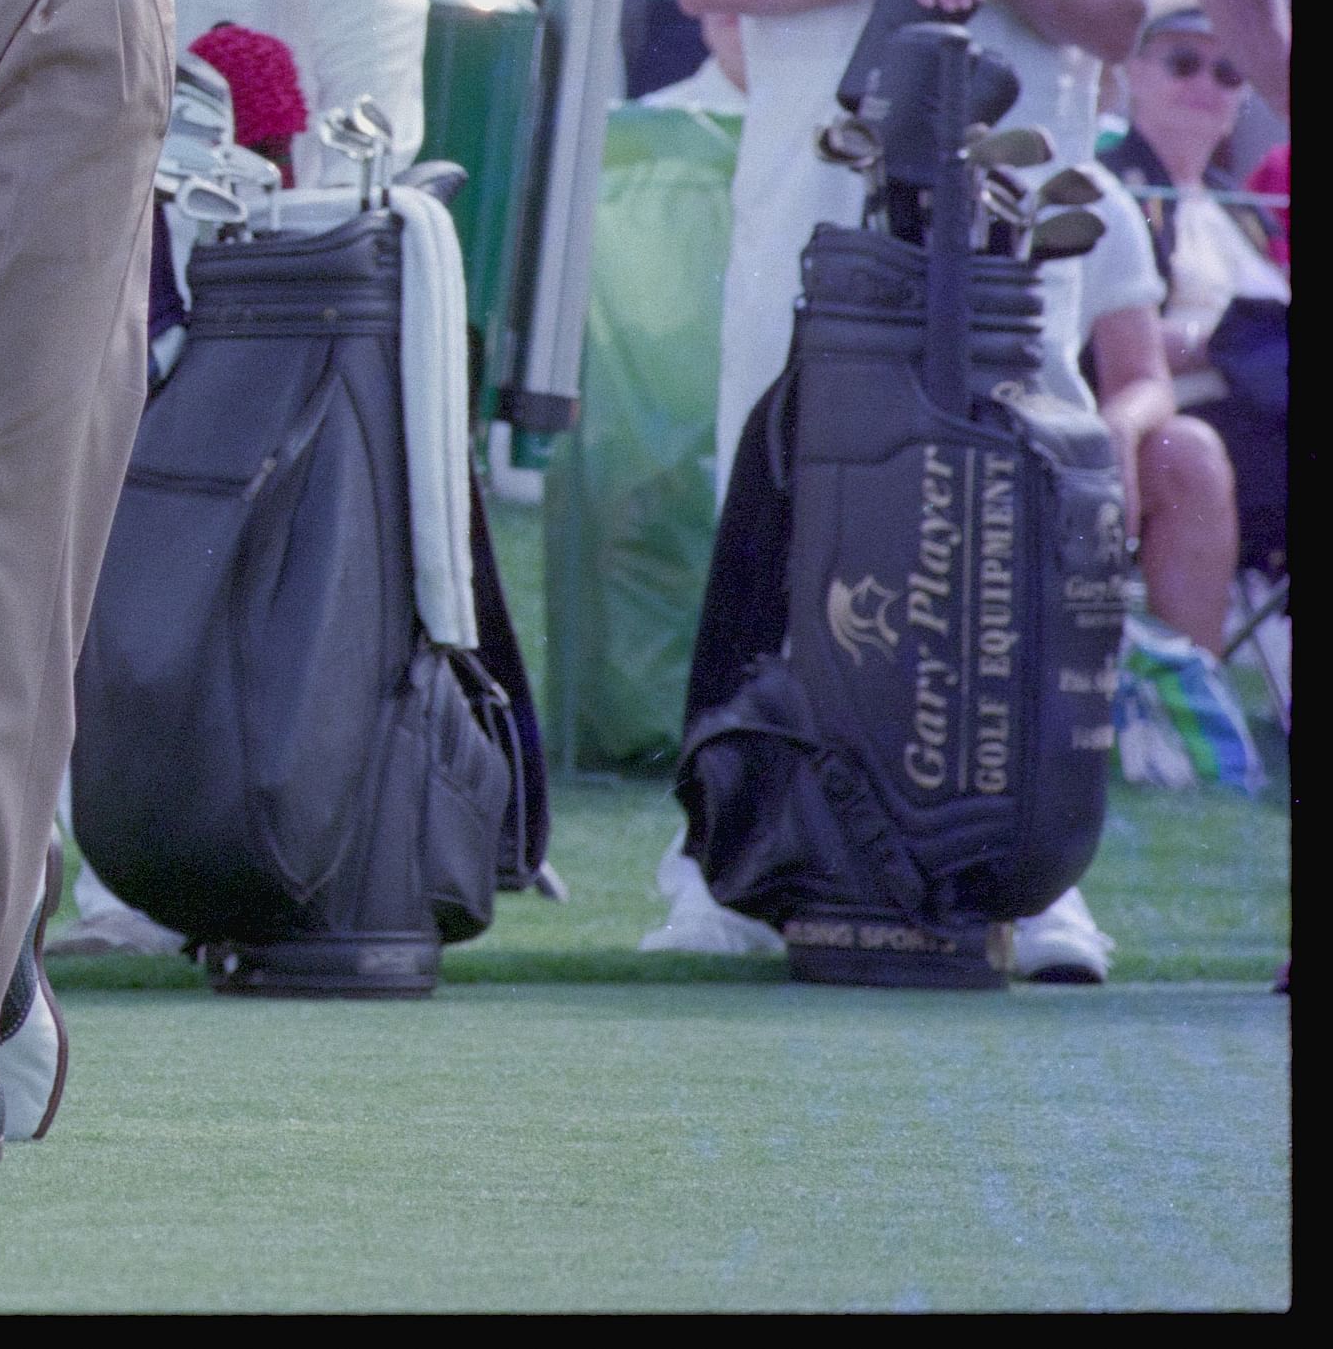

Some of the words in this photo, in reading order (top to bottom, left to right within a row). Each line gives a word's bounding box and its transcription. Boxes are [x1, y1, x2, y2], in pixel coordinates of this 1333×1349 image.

[907, 444, 963, 634] Player
[977, 453, 1021, 678] EQUIPMENT
[903, 647, 960, 790] Gary
[973, 697, 1010, 794] GOLF
